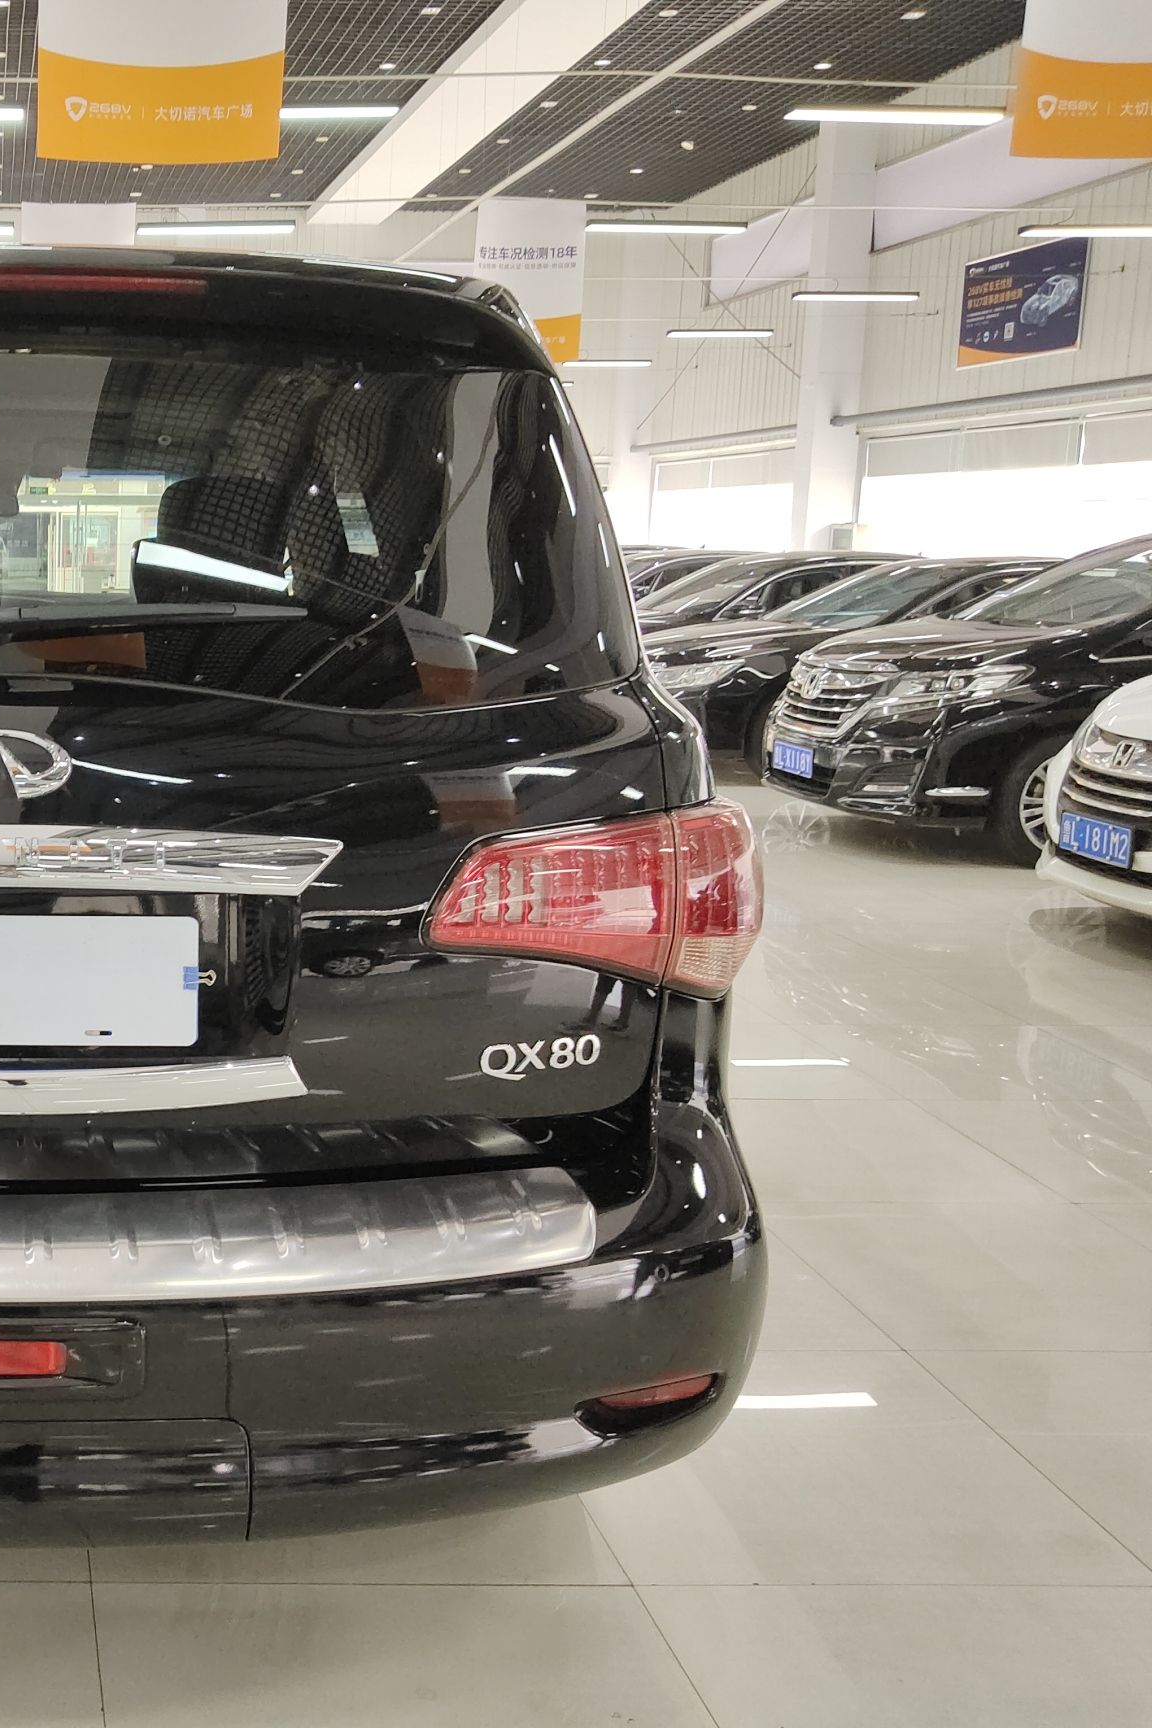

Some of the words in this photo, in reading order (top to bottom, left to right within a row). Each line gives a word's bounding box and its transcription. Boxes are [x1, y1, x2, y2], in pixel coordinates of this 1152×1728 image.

[154, 103, 253, 122] 大切诺汽车广场
[1119, 101, 1152, 118] 大切
[479, 245, 578, 261] 专注车况检测18年
[480, 1034, 601, 1081] QX80
